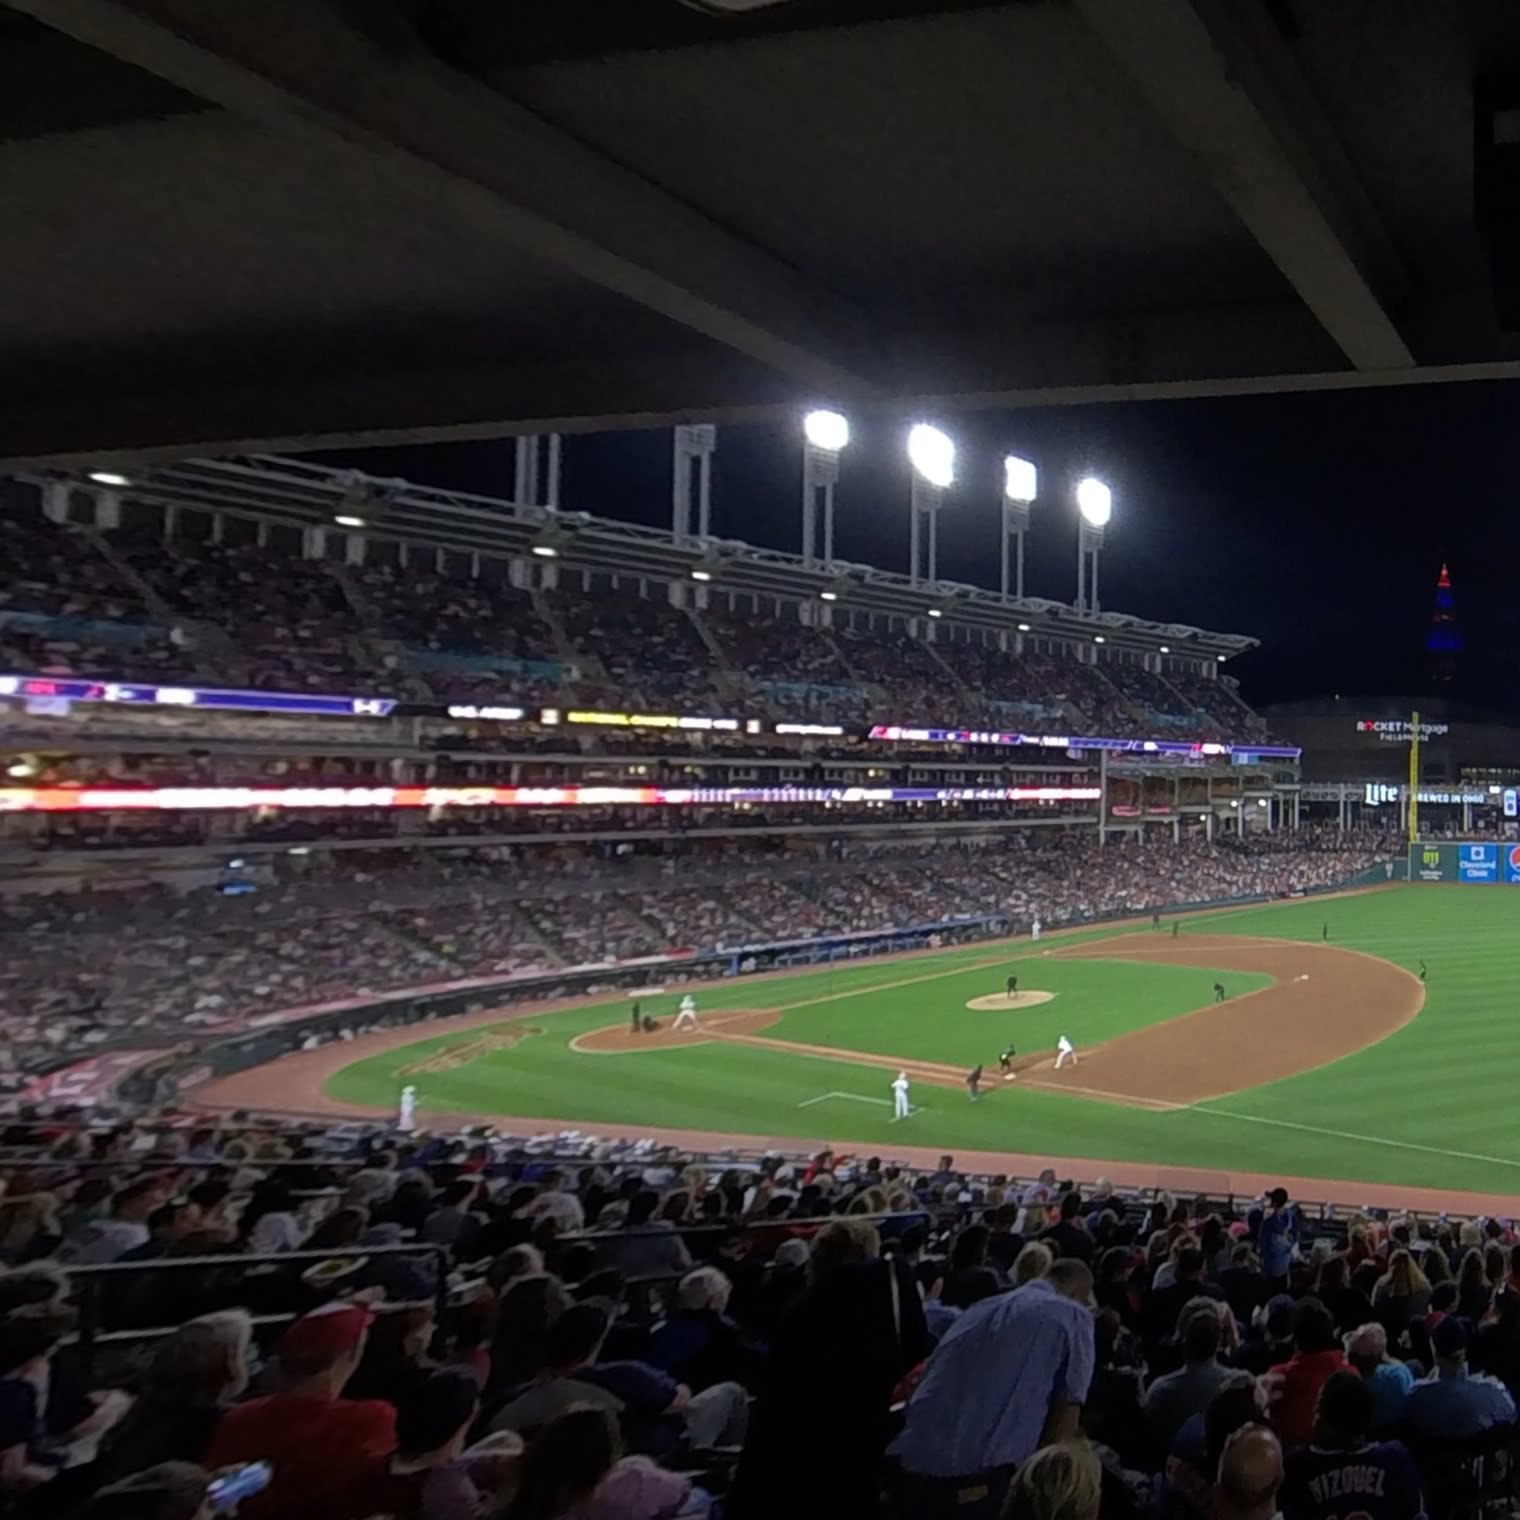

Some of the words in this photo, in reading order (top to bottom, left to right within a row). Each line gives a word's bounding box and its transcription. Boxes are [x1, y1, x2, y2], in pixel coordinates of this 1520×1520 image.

[1356, 721, 1402, 731] ROCKET
[1365, 783, 1398, 806] Lite
[1417, 793, 1449, 803] REWED
